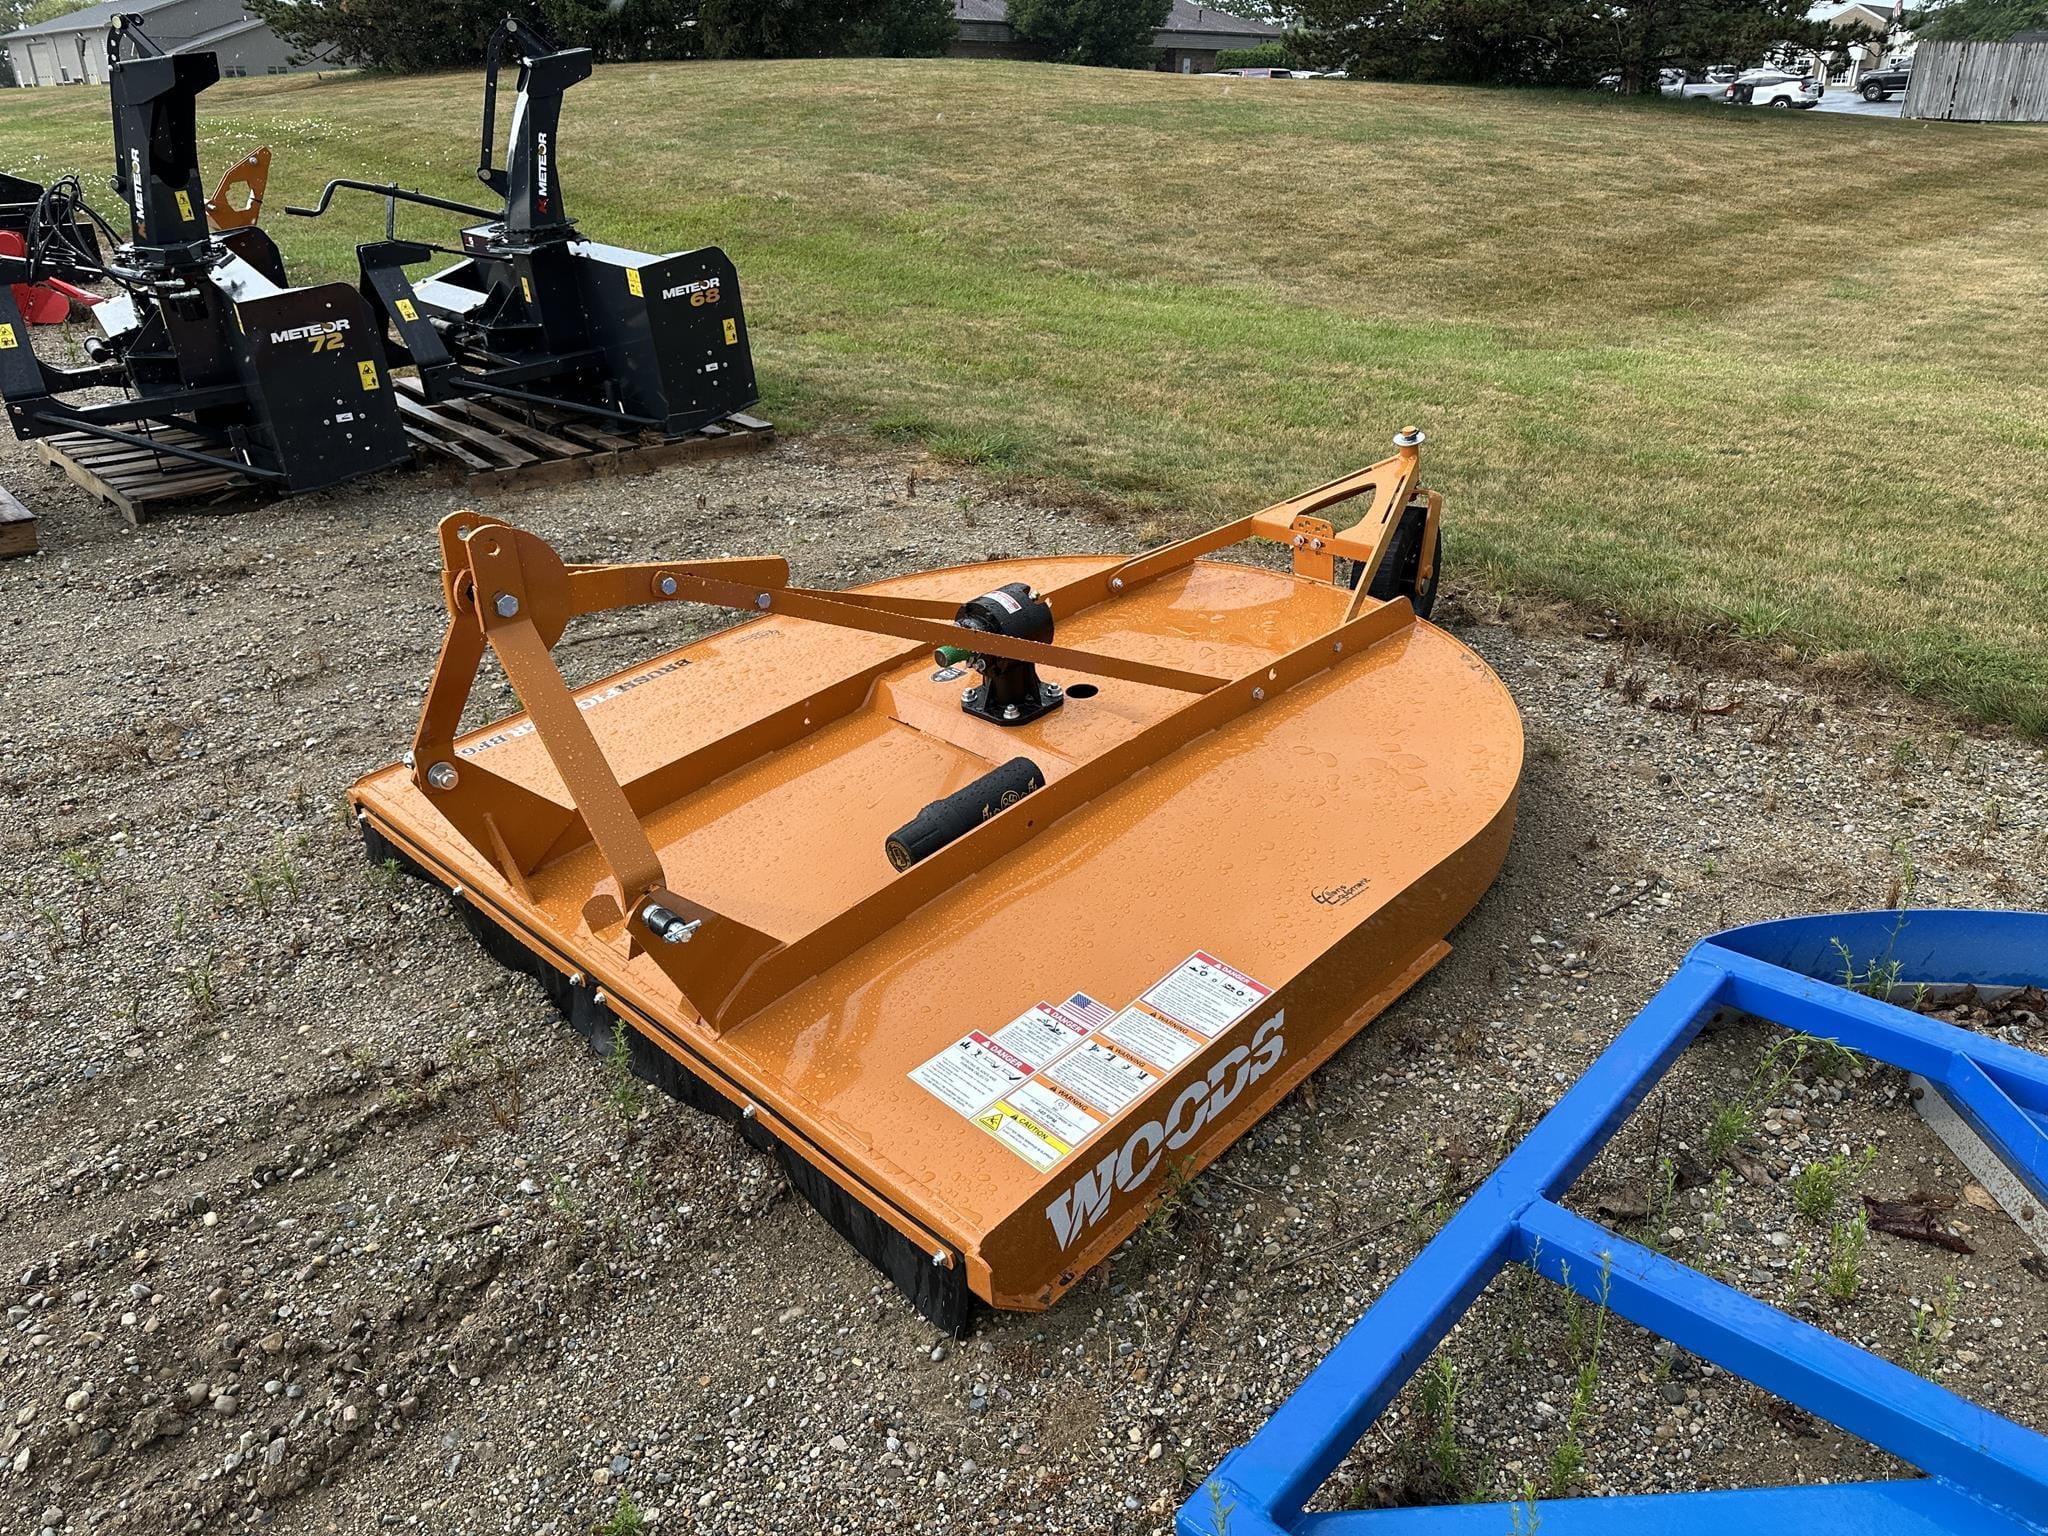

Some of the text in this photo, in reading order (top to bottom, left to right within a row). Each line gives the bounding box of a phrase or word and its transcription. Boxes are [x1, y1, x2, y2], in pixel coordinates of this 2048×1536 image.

[538, 132, 548, 197] METEOR
[130, 147, 145, 220] METEOR
[662, 277, 720, 300] METEOR
[690, 288, 721, 307] 68
[270, 319, 351, 344] METEOR
[308, 332, 345, 354] 72
[1221, 964, 1250, 984] DANGER
[1050, 1011, 1082, 1033] DANGER
[1159, 1016, 1189, 1034] WARNING
[989, 1044, 1024, 1069] DANGER
[1115, 1048, 1146, 1068] WARNING
[1058, 1089, 1089, 1111] WARNING
[1018, 1118, 1049, 1140] CAUTION
[1045, 1008, 1285, 1252] WOODS
